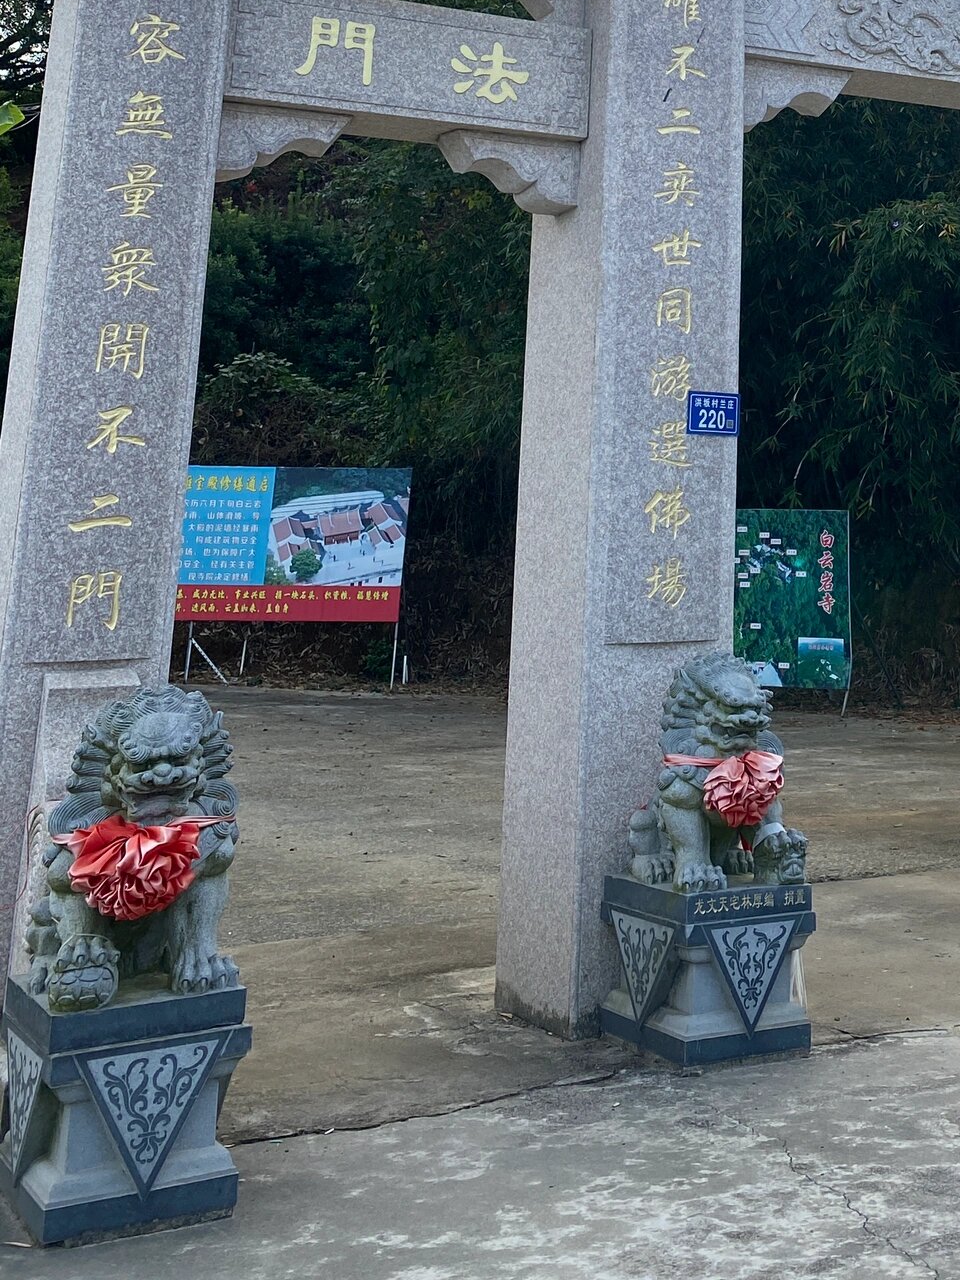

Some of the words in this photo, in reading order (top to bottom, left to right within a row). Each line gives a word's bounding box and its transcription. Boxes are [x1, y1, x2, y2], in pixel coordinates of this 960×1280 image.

[294, 16, 530, 105] 法門
[698, 409, 726, 430] 220
[817, 529, 837, 615] 白云岩寺
